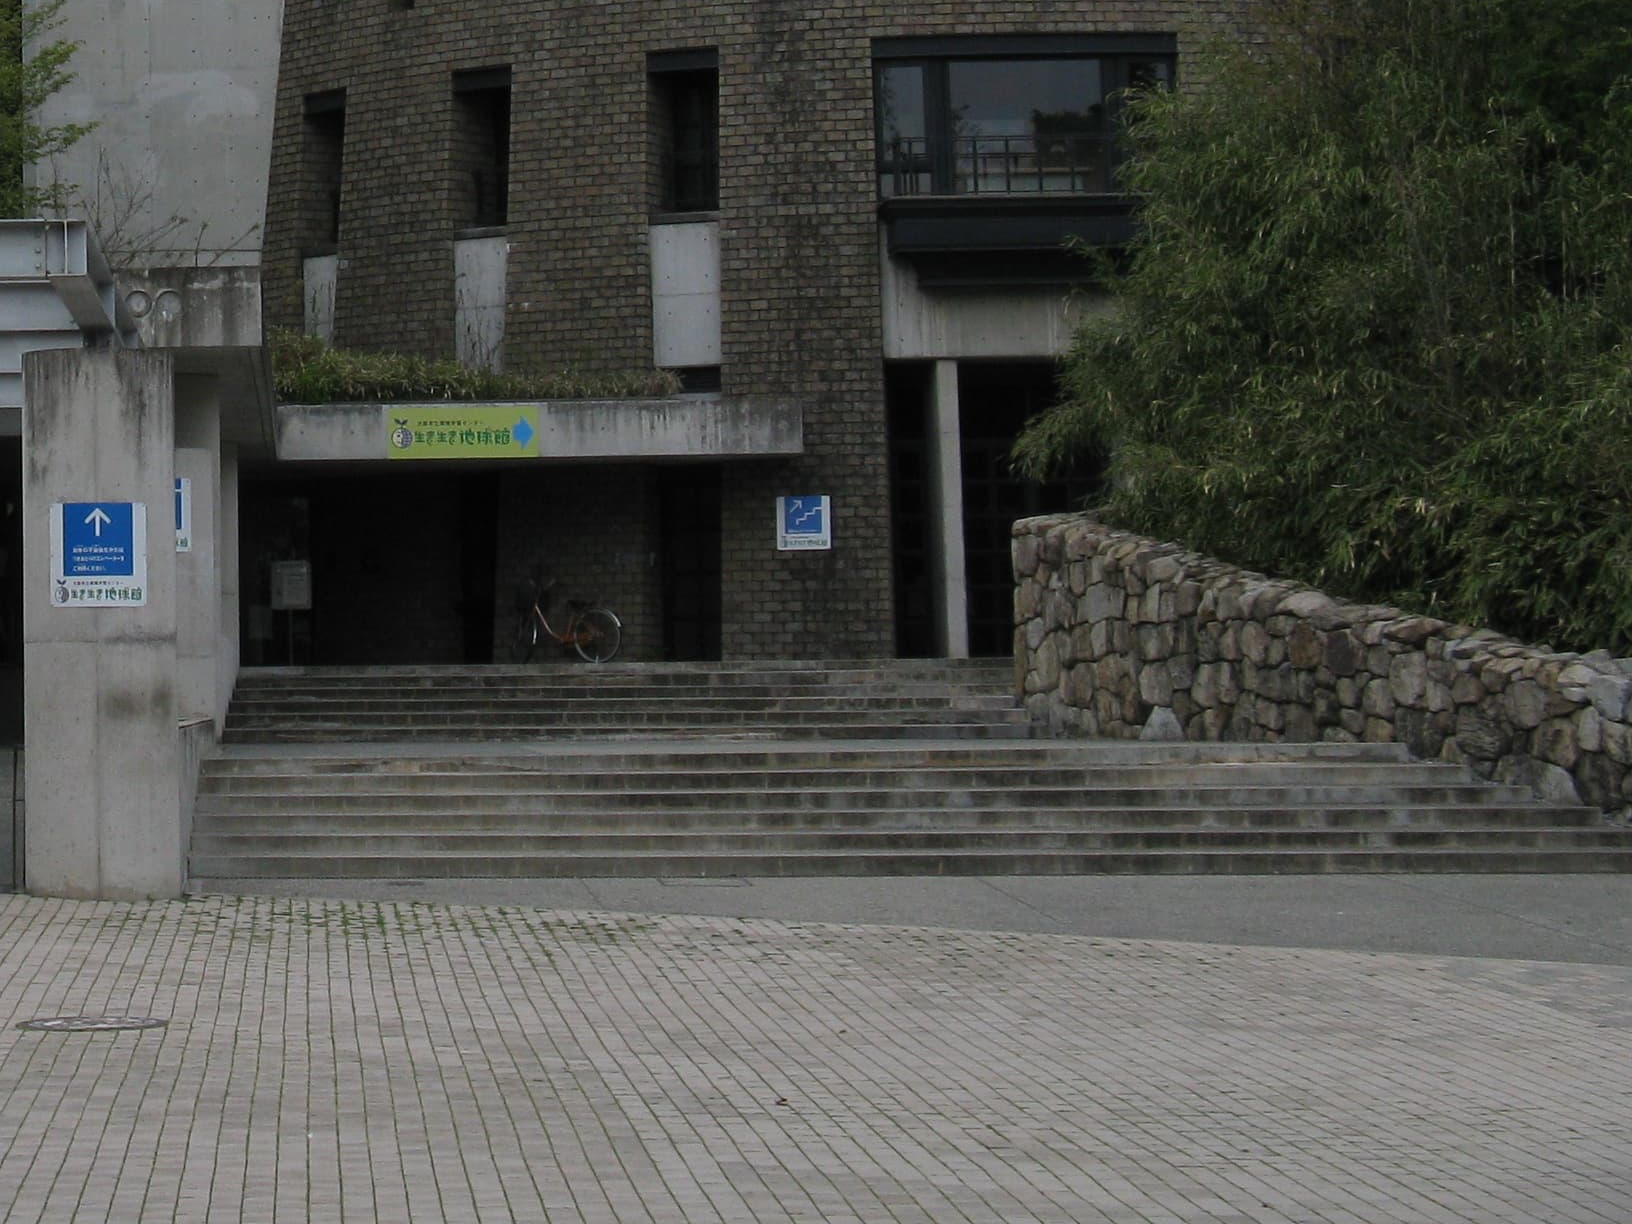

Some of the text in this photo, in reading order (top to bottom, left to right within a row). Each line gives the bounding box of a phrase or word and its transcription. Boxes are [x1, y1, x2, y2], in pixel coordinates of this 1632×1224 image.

[414, 428, 511, 446] 生き生き地球館
